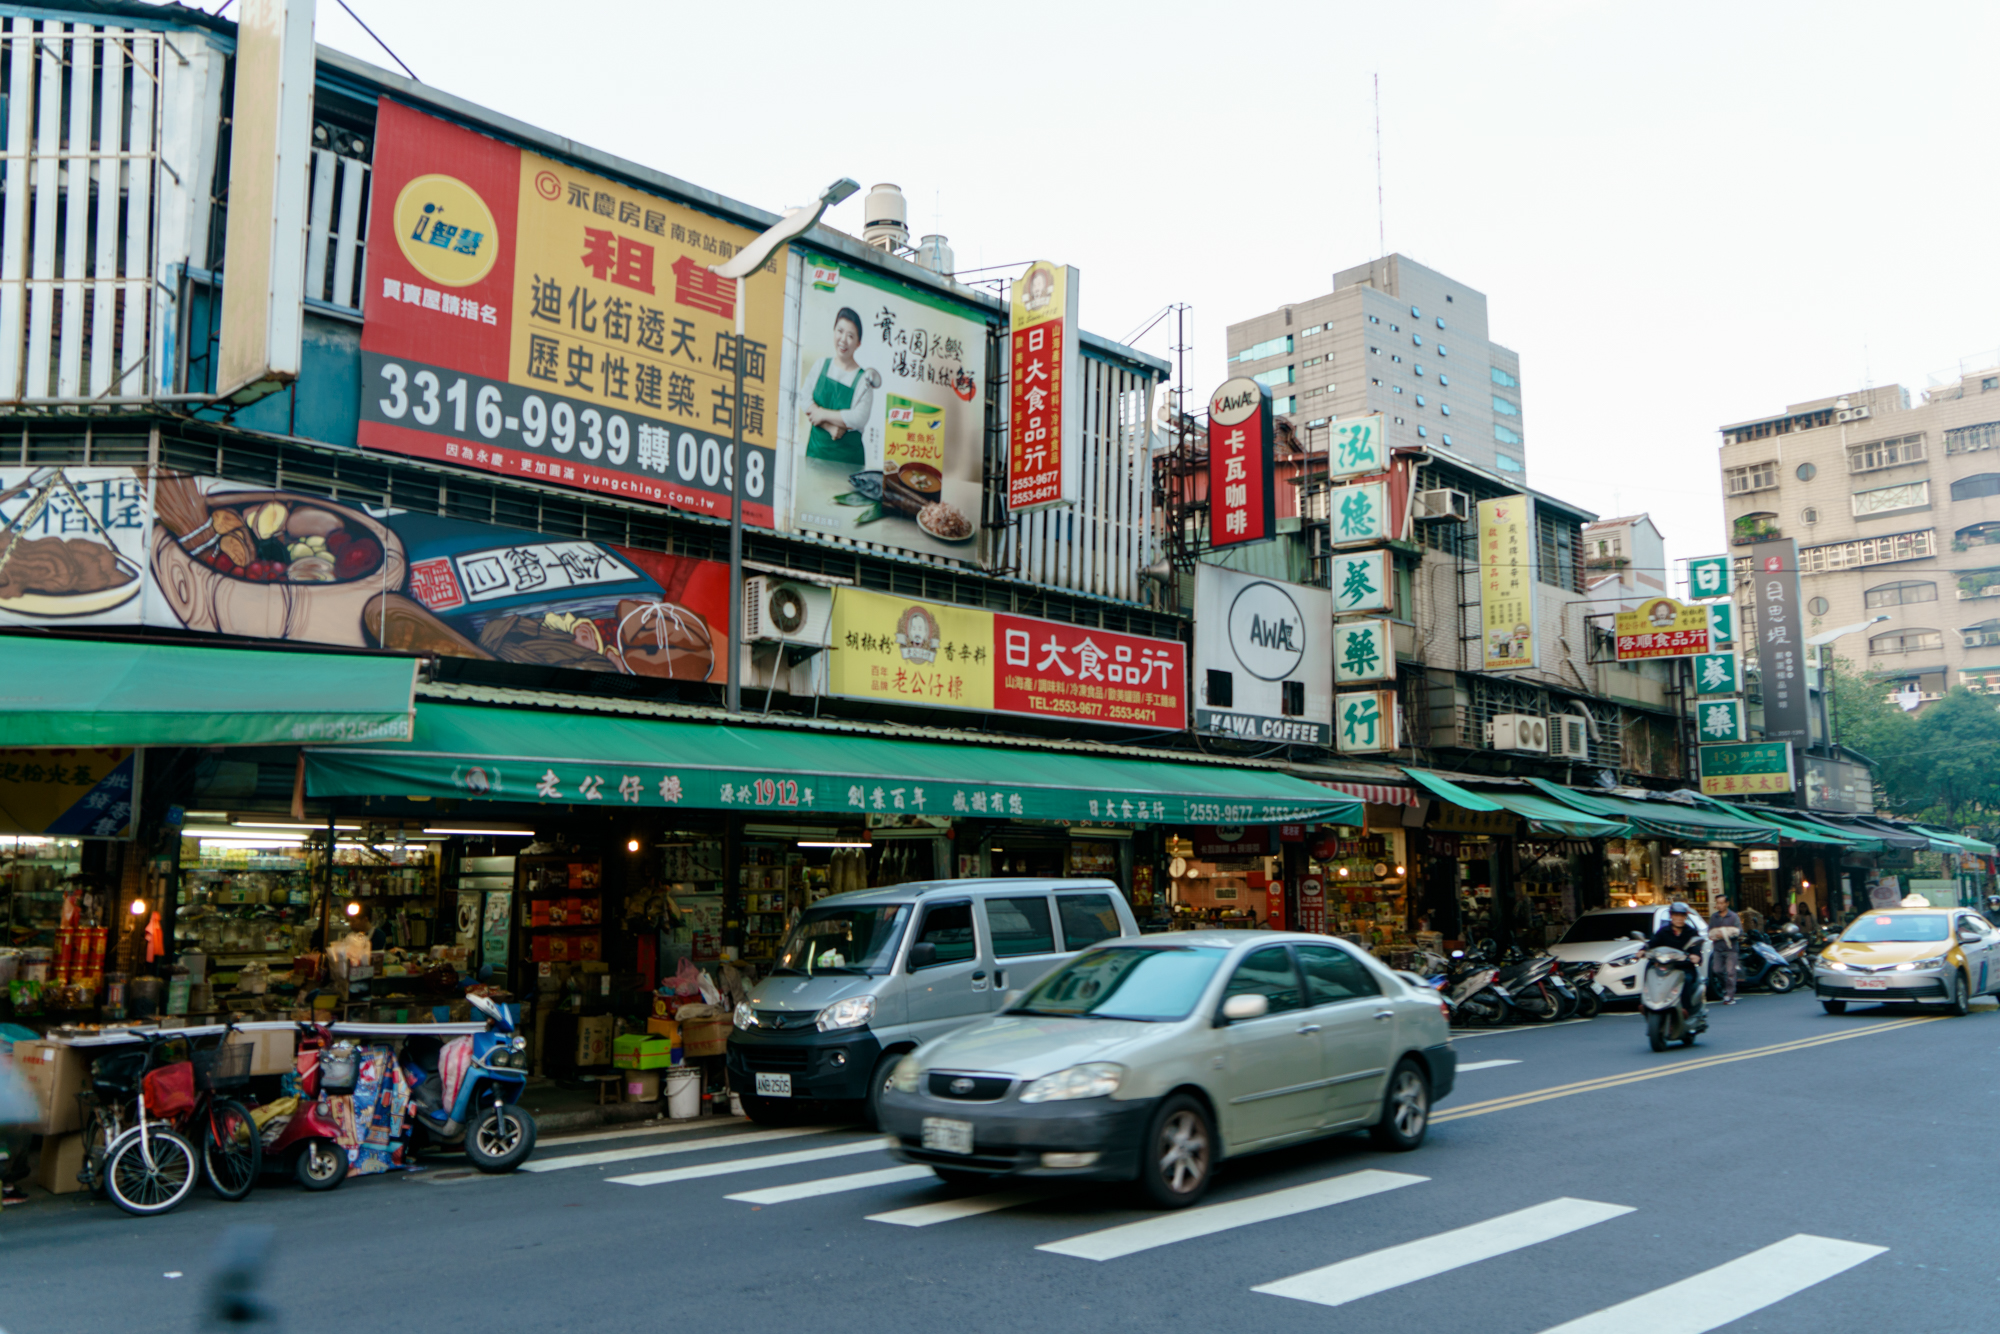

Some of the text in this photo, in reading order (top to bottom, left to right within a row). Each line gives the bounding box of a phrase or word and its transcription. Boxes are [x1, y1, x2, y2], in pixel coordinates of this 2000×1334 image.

[567, 181, 666, 237] 永慶房屋
[1024, 327, 1049, 472] 日大食品行
[379, 362, 631, 466] 3316-9939
[636, 423, 670, 475] 轉
[886, 441, 943, 460] かつおだし
[582, 471, 716, 509] yungching.com.tw
[1011, 470, 1059, 491] 2553-9677
[1011, 485, 1058, 505] 2553-6471
[1224, 429, 1248, 535] 卡瓦咖啡
[844, 631, 987, 667] 胡椒粉 香辛料
[1005, 628, 1174, 690] 日大食品行
[871, 665, 889, 678] 百年
[892, 666, 964, 700] 老公仔標
[1109, 704, 1157, 723] 2553-6471
[1210, 713, 1319, 743] KAWA COFFEE
[536, 768, 684, 804] 老公仔標
[848, 784, 928, 812] 創業百年
[952, 789, 1024, 816] 感謝有您
[1089, 799, 1166, 821] 日大食品行
[1190, 803, 1253, 823] 2553-9677
